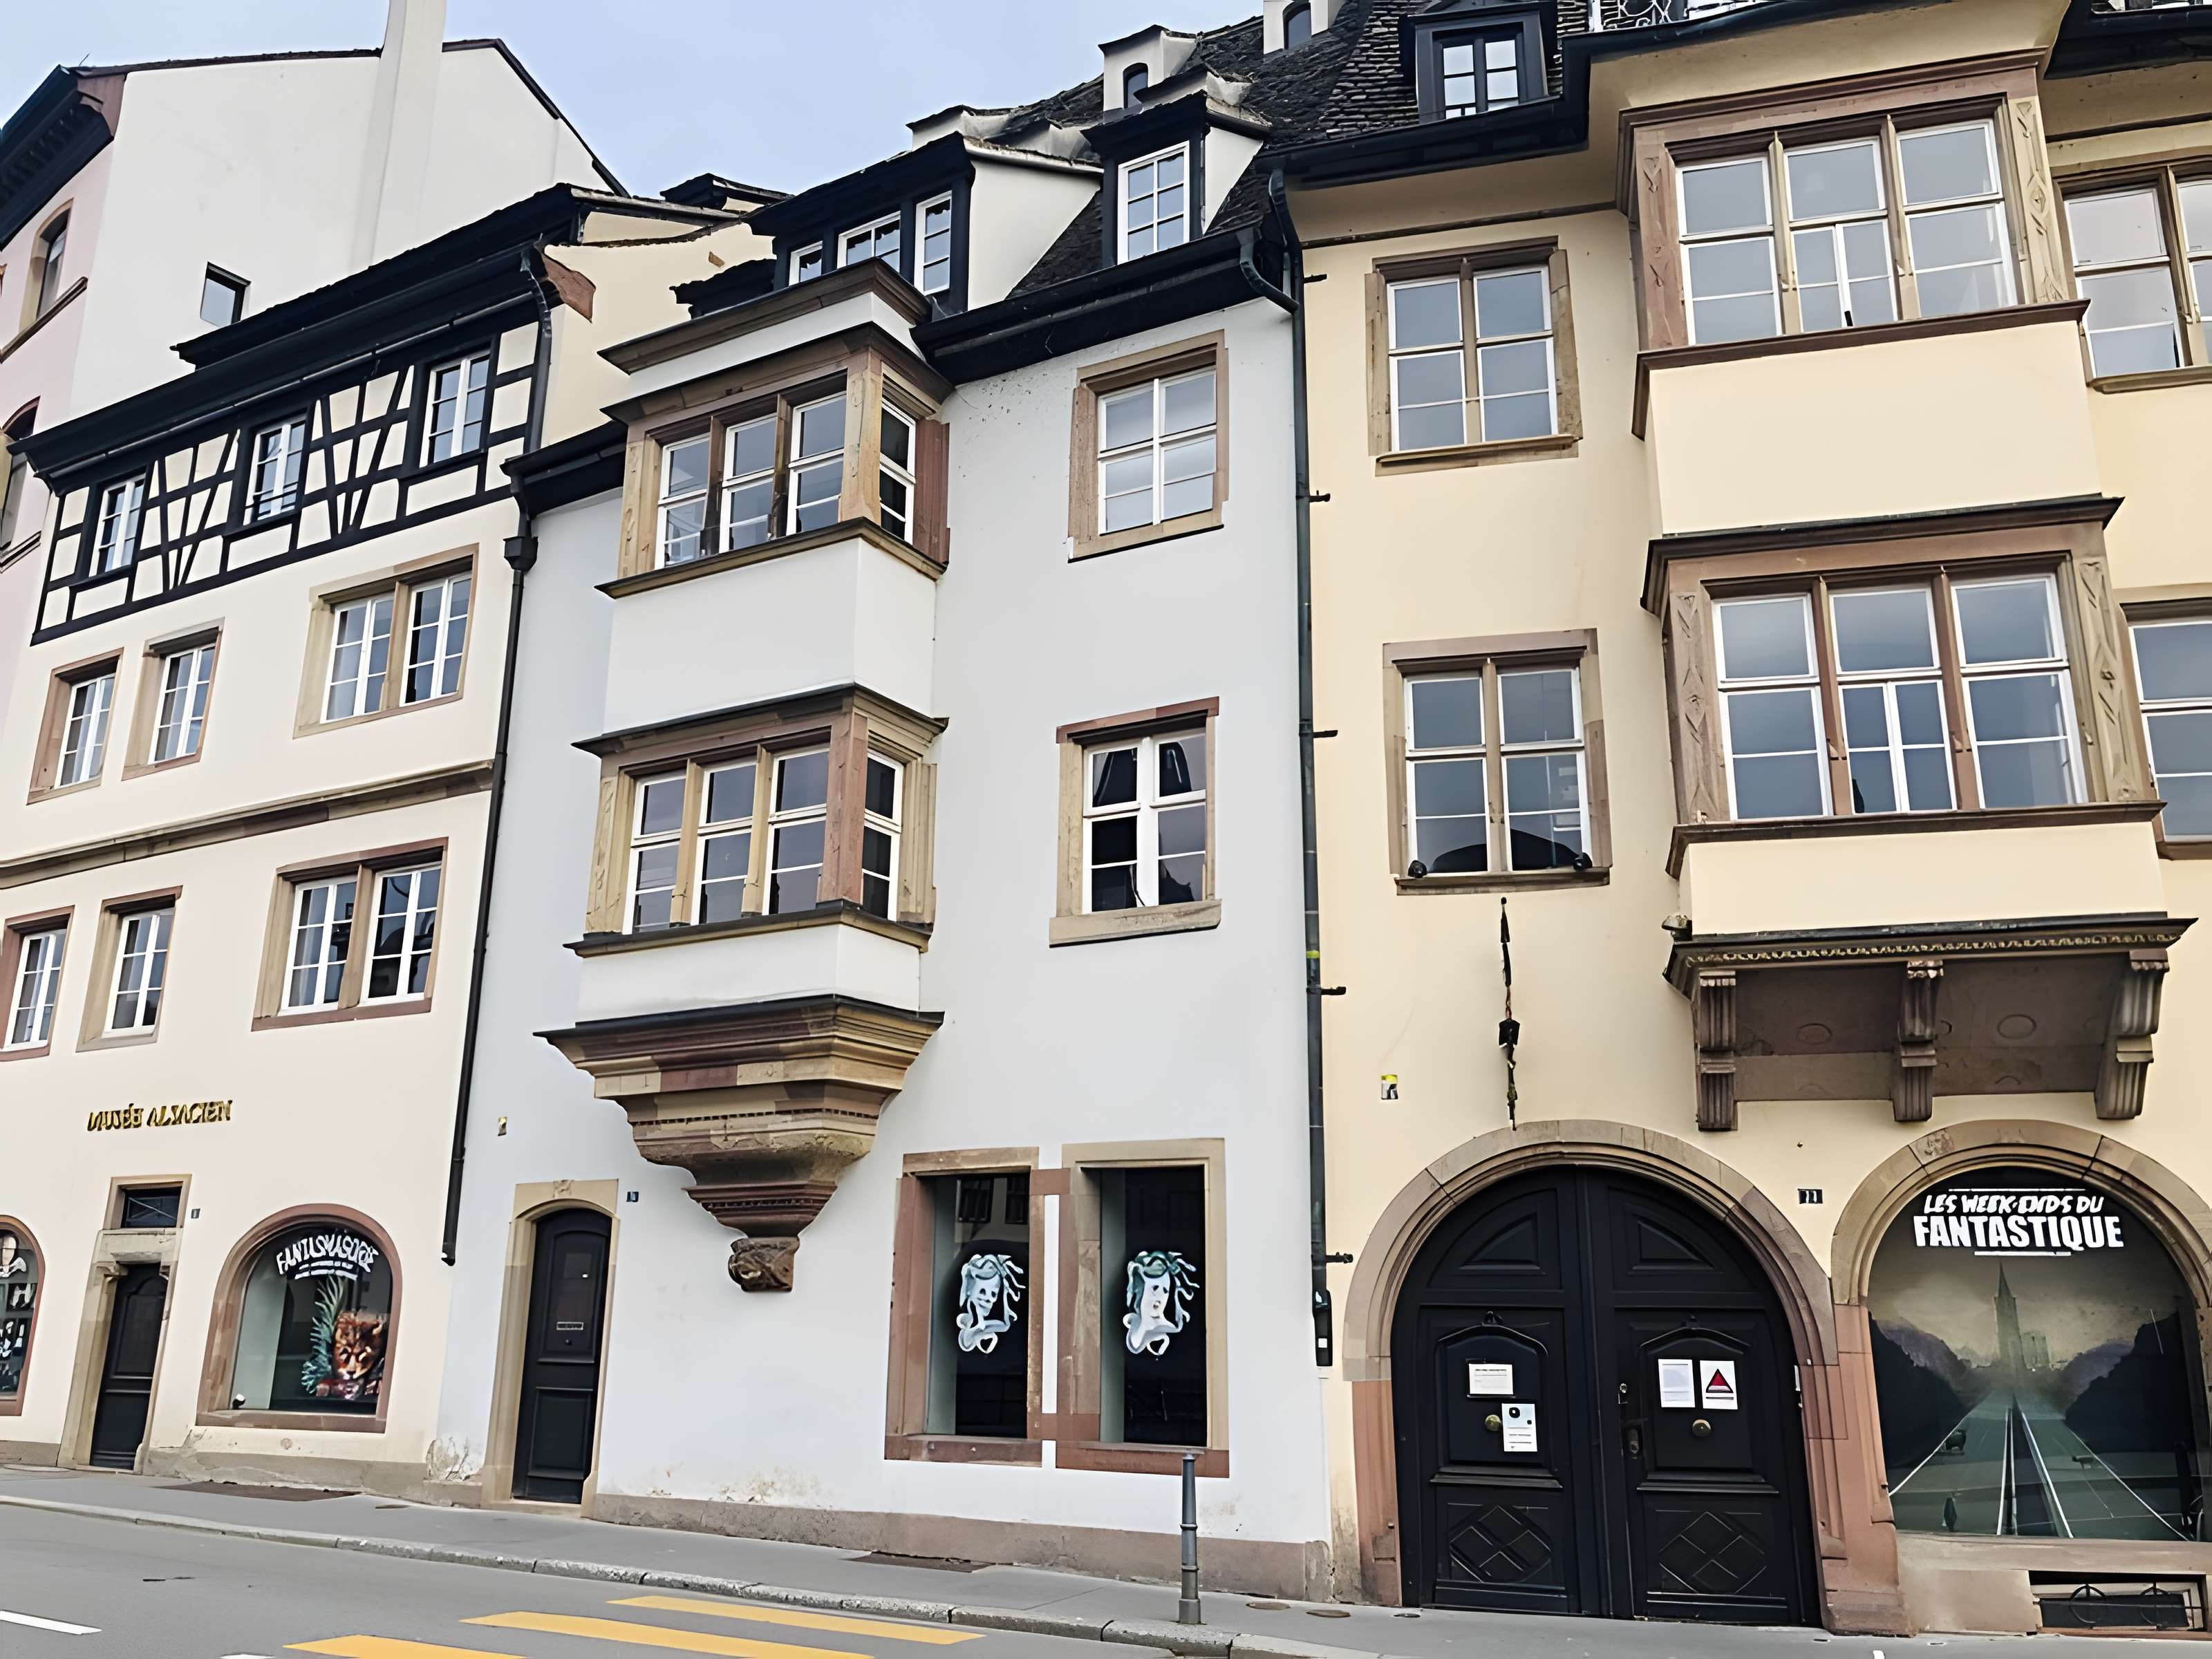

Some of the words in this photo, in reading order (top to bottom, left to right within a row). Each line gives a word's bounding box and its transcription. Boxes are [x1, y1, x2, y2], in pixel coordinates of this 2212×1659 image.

[1924, 1194, 1957, 1214] LES
[2076, 1196, 2104, 1213] DU
[1913, 1215, 2124, 1251] FANTASTIQUE
